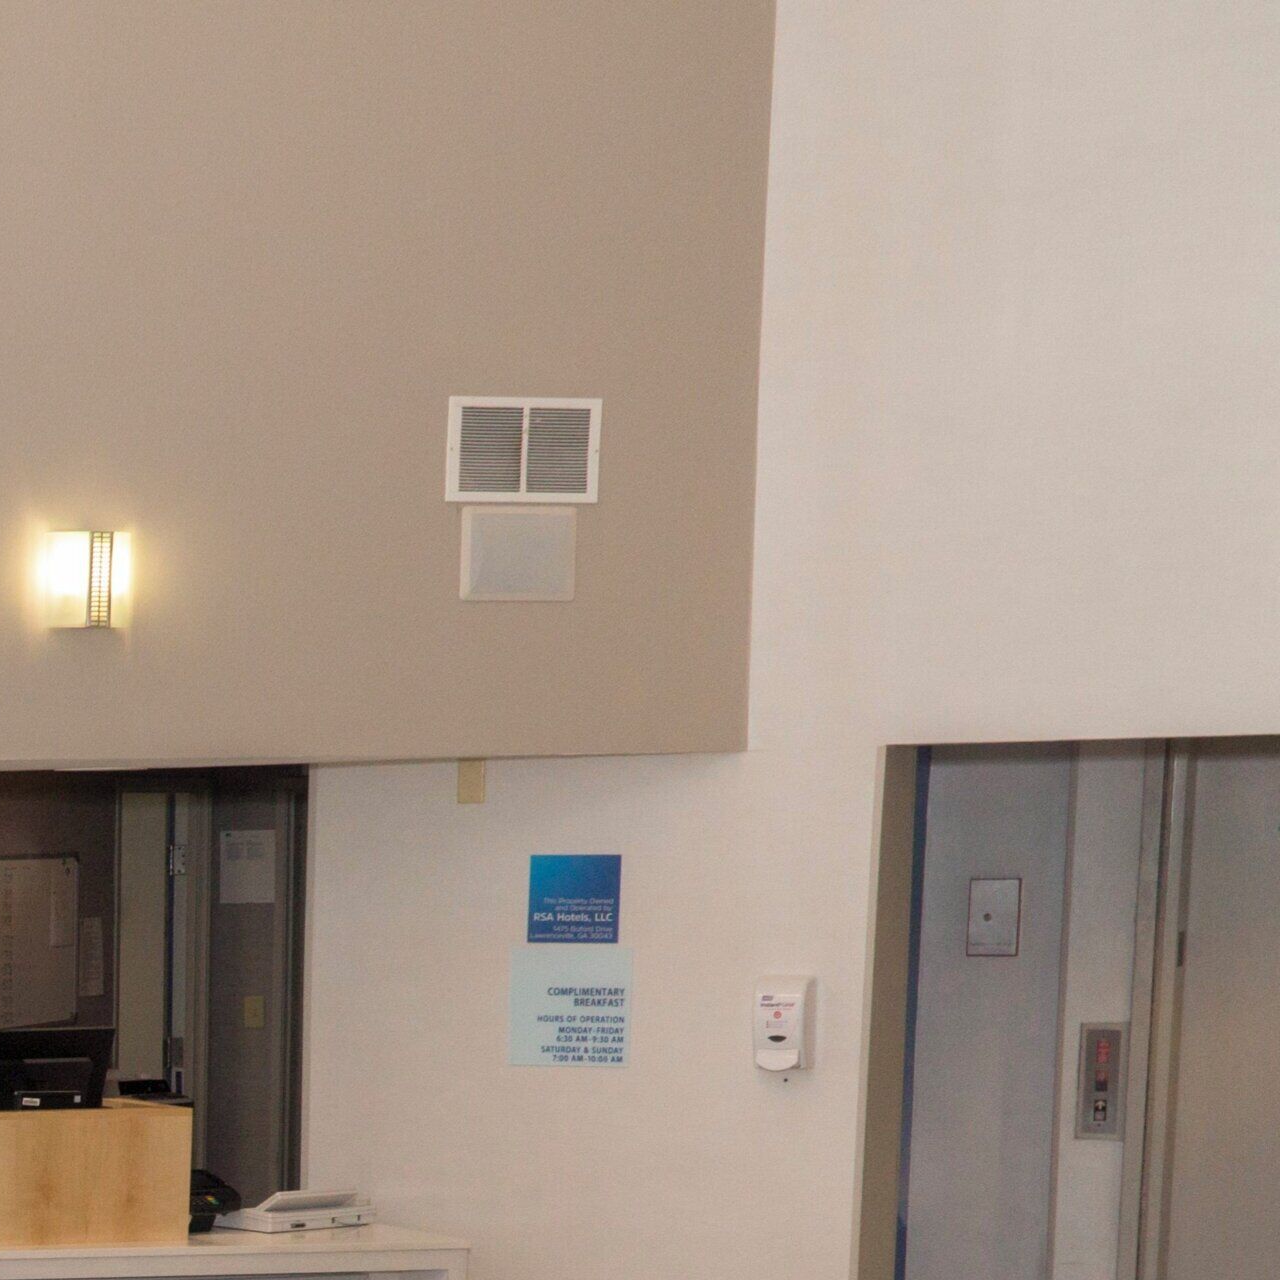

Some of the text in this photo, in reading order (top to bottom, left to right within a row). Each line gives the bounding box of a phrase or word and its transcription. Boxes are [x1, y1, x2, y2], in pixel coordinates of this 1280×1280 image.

[533, 912, 614, 922] RSA Hotels, LLC
[547, 987, 625, 996] COMPLIMENTARY
[573, 998, 625, 1007] BREAKFAST
[579, 1015, 625, 1023] OPERATION
[591, 1046, 624, 1054] SUNDAY
